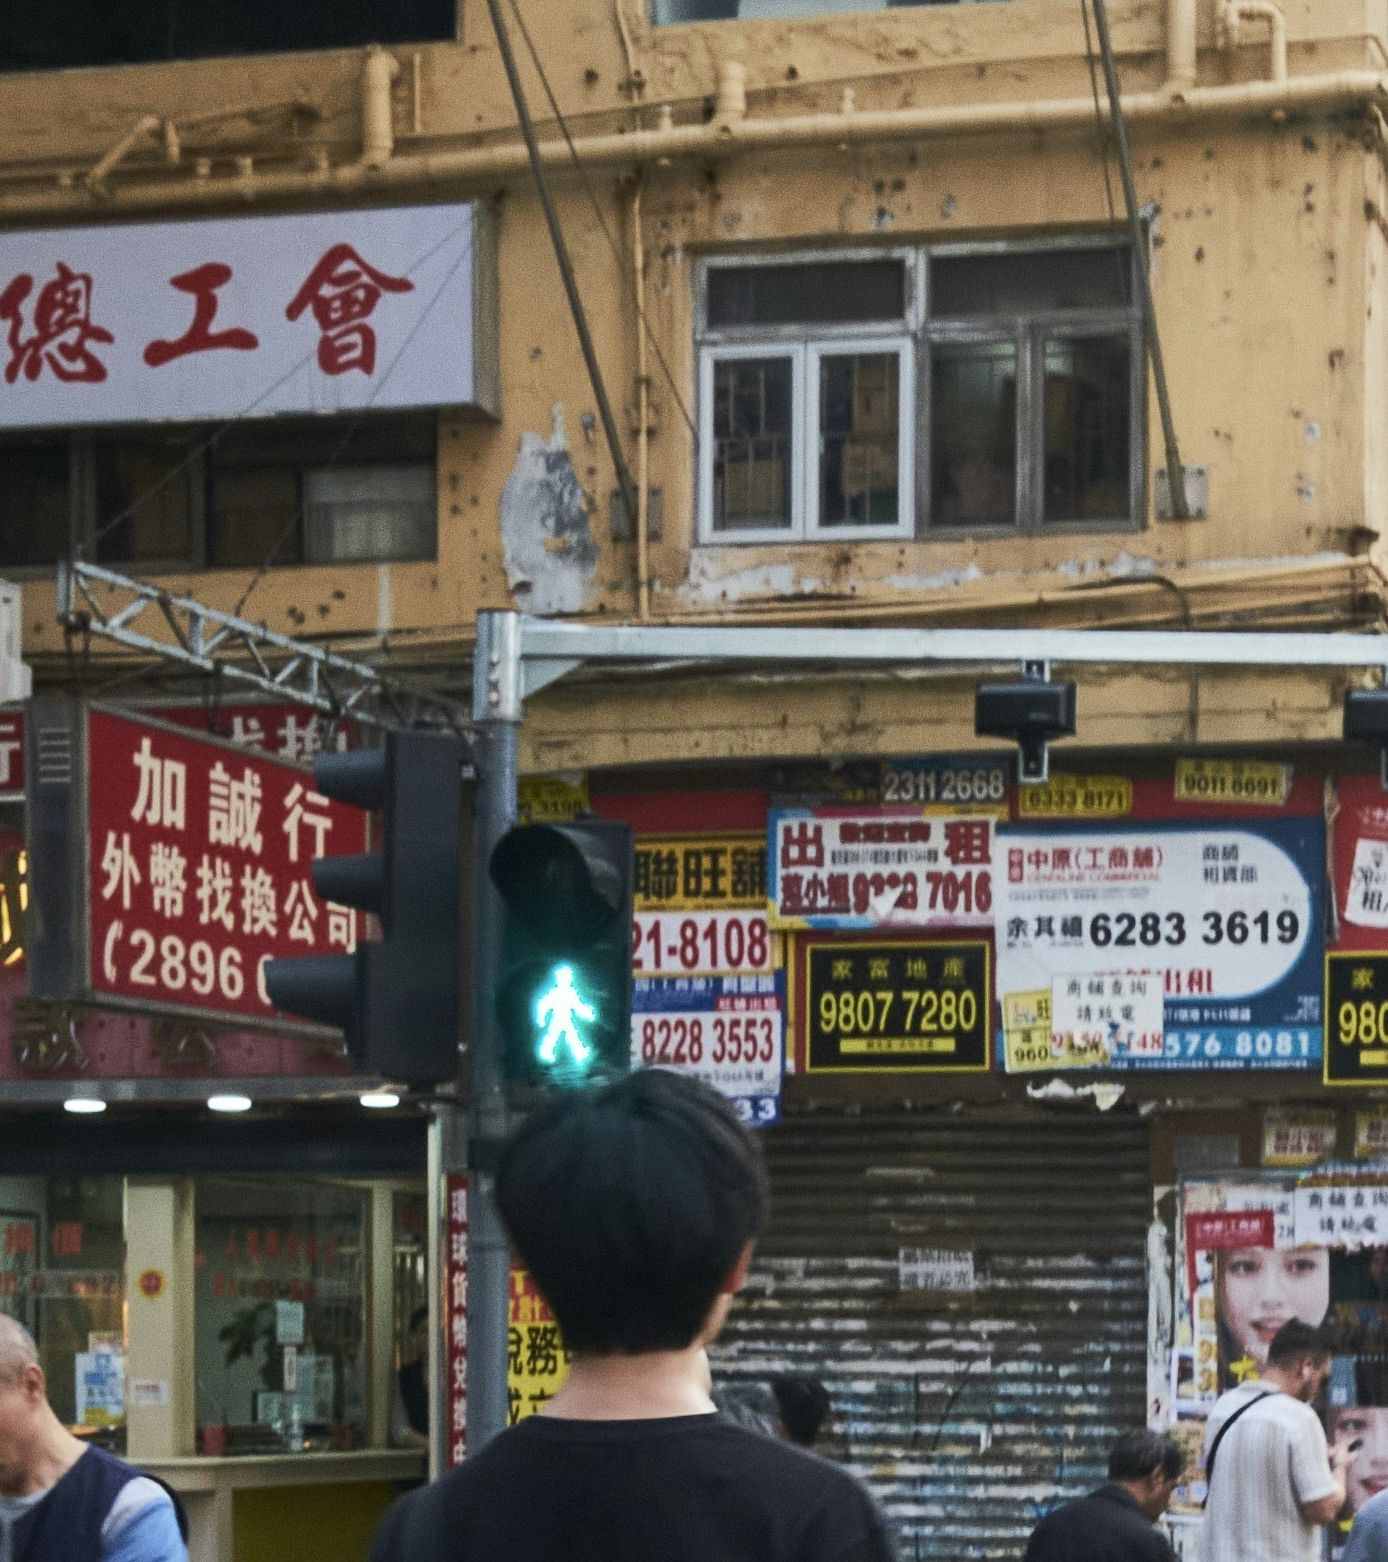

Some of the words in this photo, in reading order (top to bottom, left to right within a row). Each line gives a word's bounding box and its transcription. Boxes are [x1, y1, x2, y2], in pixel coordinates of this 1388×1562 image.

[131, 737, 332, 861] 加誠行
[940, 768, 1005, 800] 2668
[781, 822, 825, 868] 出
[943, 820, 992, 865] 租
[101, 831, 356, 954] 外幣找換公司
[634, 846, 768, 901] 聯旺舖
[631, 916, 769, 970] 21-8108
[1089, 911, 1186, 948] 6283
[1201, 909, 1300, 946] 3619
[103, 920, 244, 1000] (2896
[819, 990, 894, 1034] 9807
[901, 989, 977, 1033] 7280
[642, 1017, 704, 1064] 8228
[712, 1017, 774, 1064] 3553
[1164, 1032, 1222, 1057] 576
[1235, 1031, 1310, 1057] 8081
